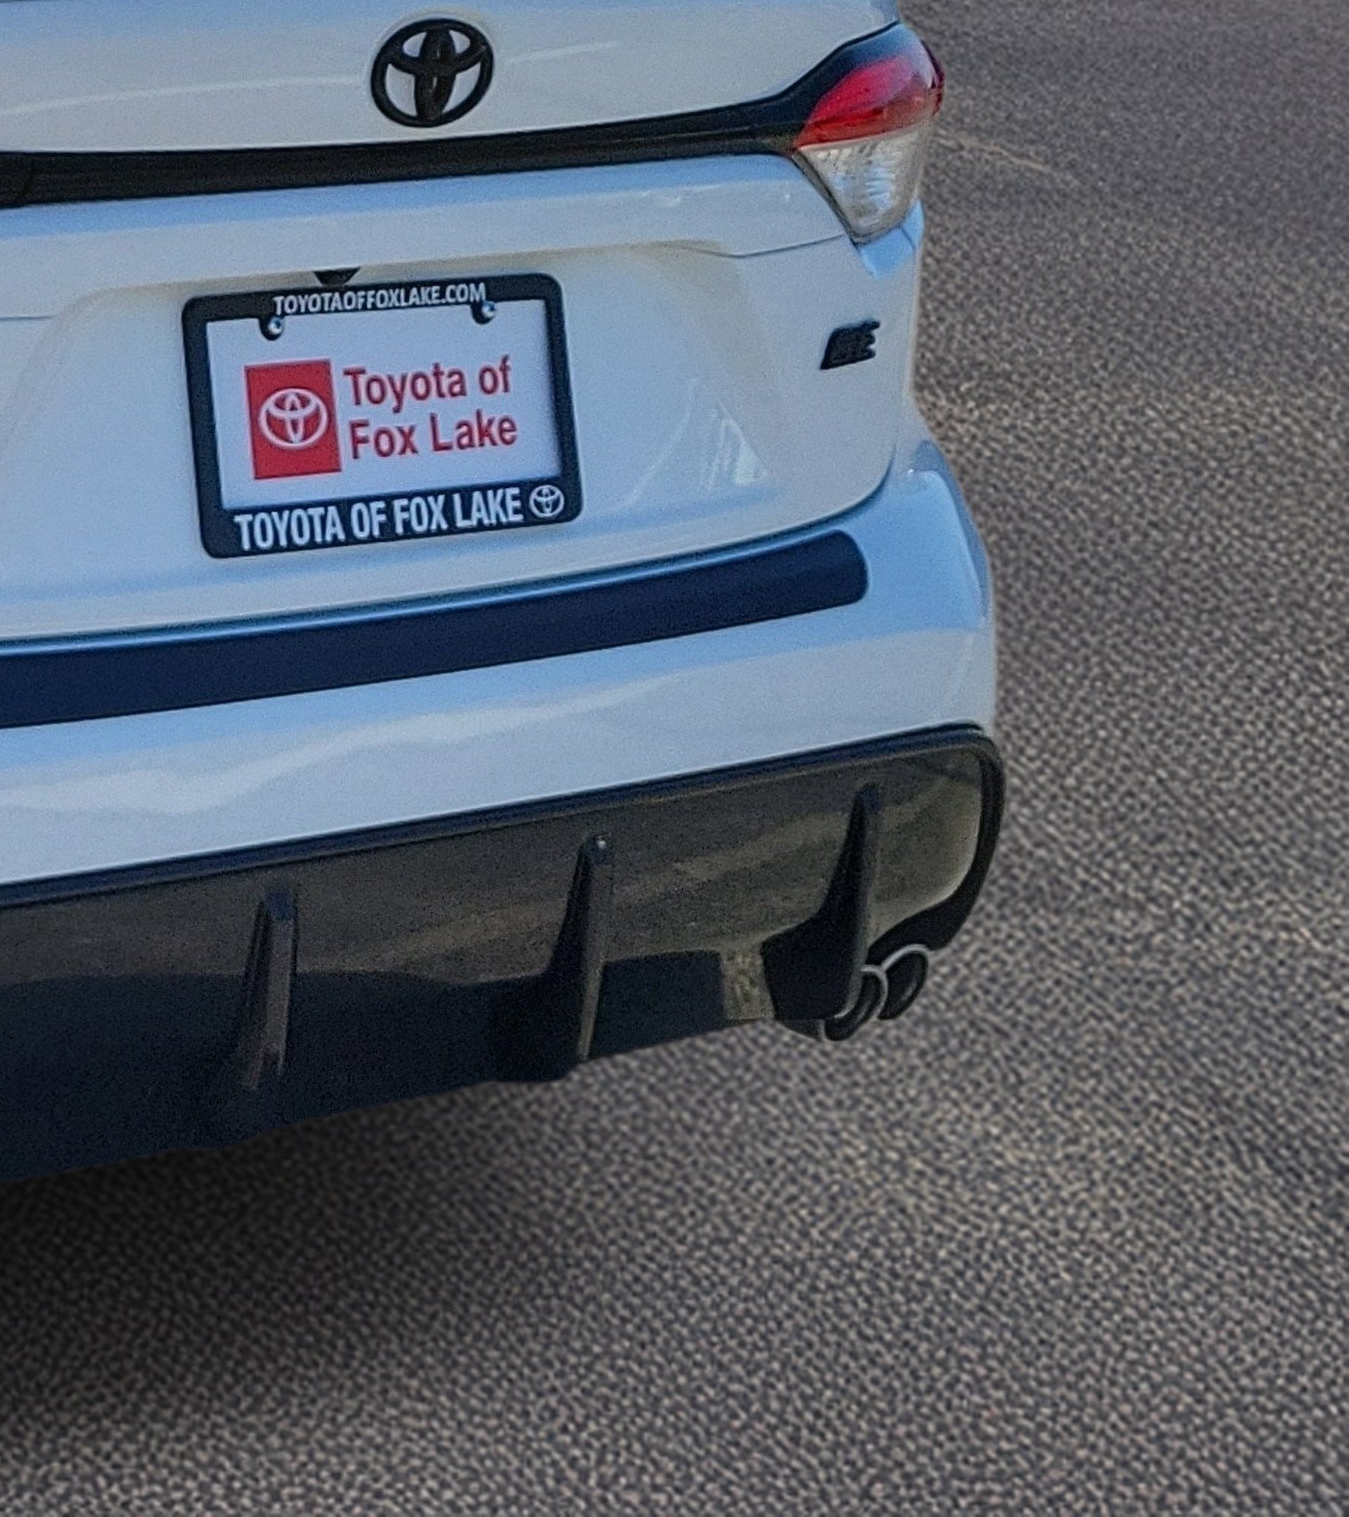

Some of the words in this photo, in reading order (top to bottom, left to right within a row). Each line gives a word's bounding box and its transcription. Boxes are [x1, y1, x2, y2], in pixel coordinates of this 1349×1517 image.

[273, 282, 487, 316] TOYOTAOFFOXLAKE.COM
[343, 363, 467, 414] Toyota
[479, 354, 512, 395] of
[348, 417, 418, 460] Fox
[430, 410, 519, 453] Lake
[234, 506, 346, 551] TOYOTA
[350, 501, 387, 539] OF
[391, 496, 448, 536] FOX
[452, 487, 524, 529] LAKE
